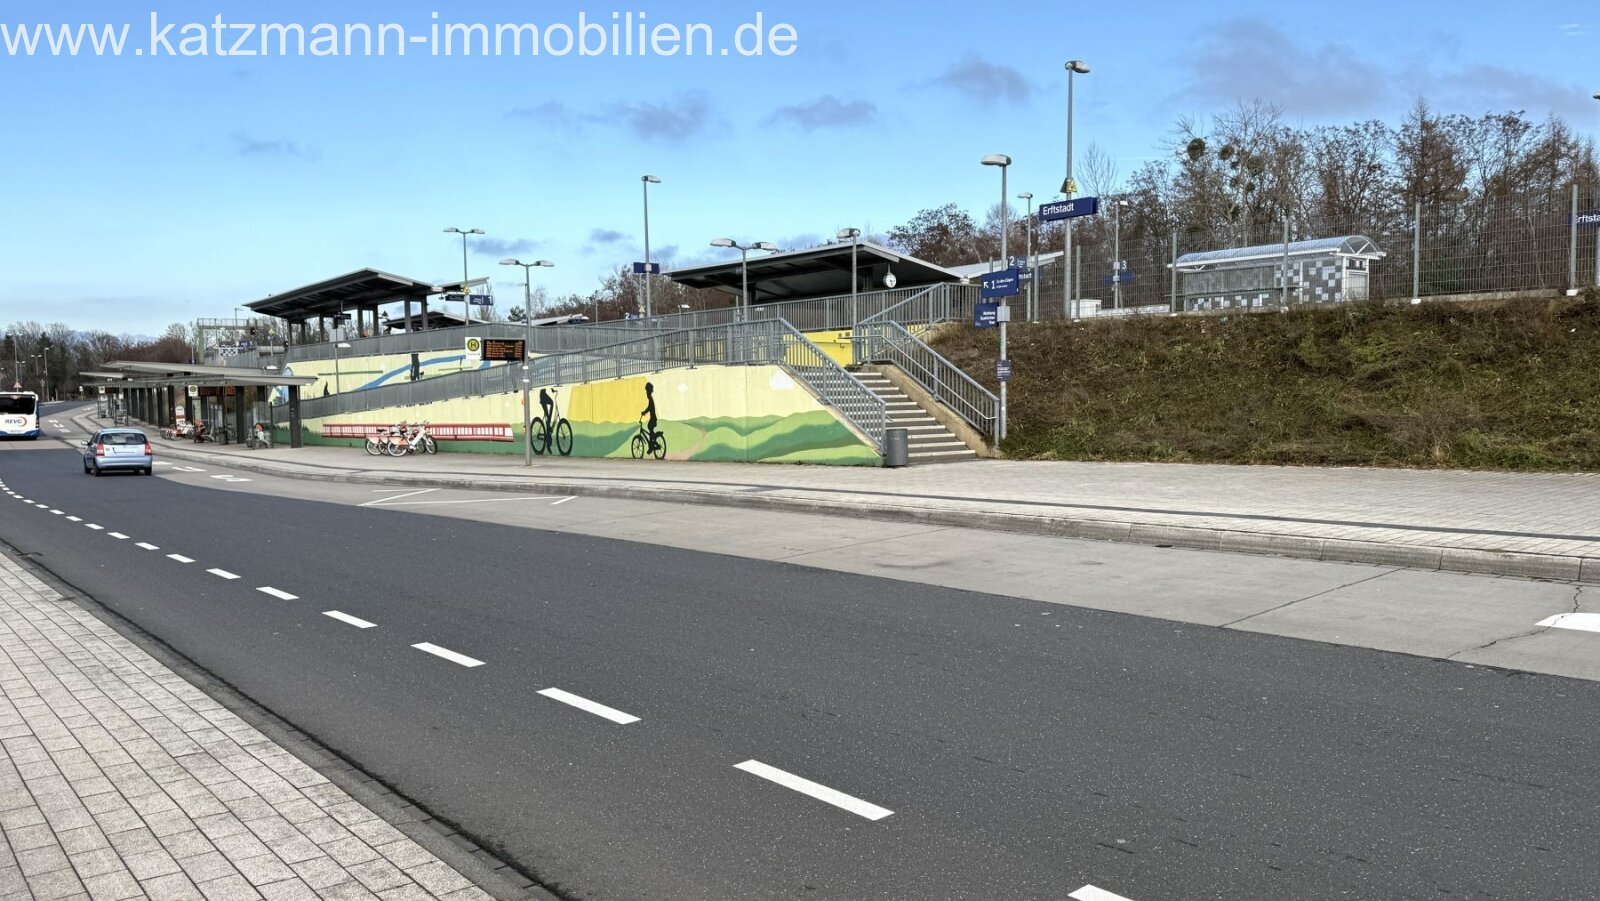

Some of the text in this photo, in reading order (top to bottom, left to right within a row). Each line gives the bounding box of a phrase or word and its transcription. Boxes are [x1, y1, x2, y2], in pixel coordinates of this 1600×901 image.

[1043, 202, 1074, 215] Erftstadt
[1009, 256, 1015, 266] 2
[1122, 260, 1127, 270] 3
[991, 280, 996, 290] 1
